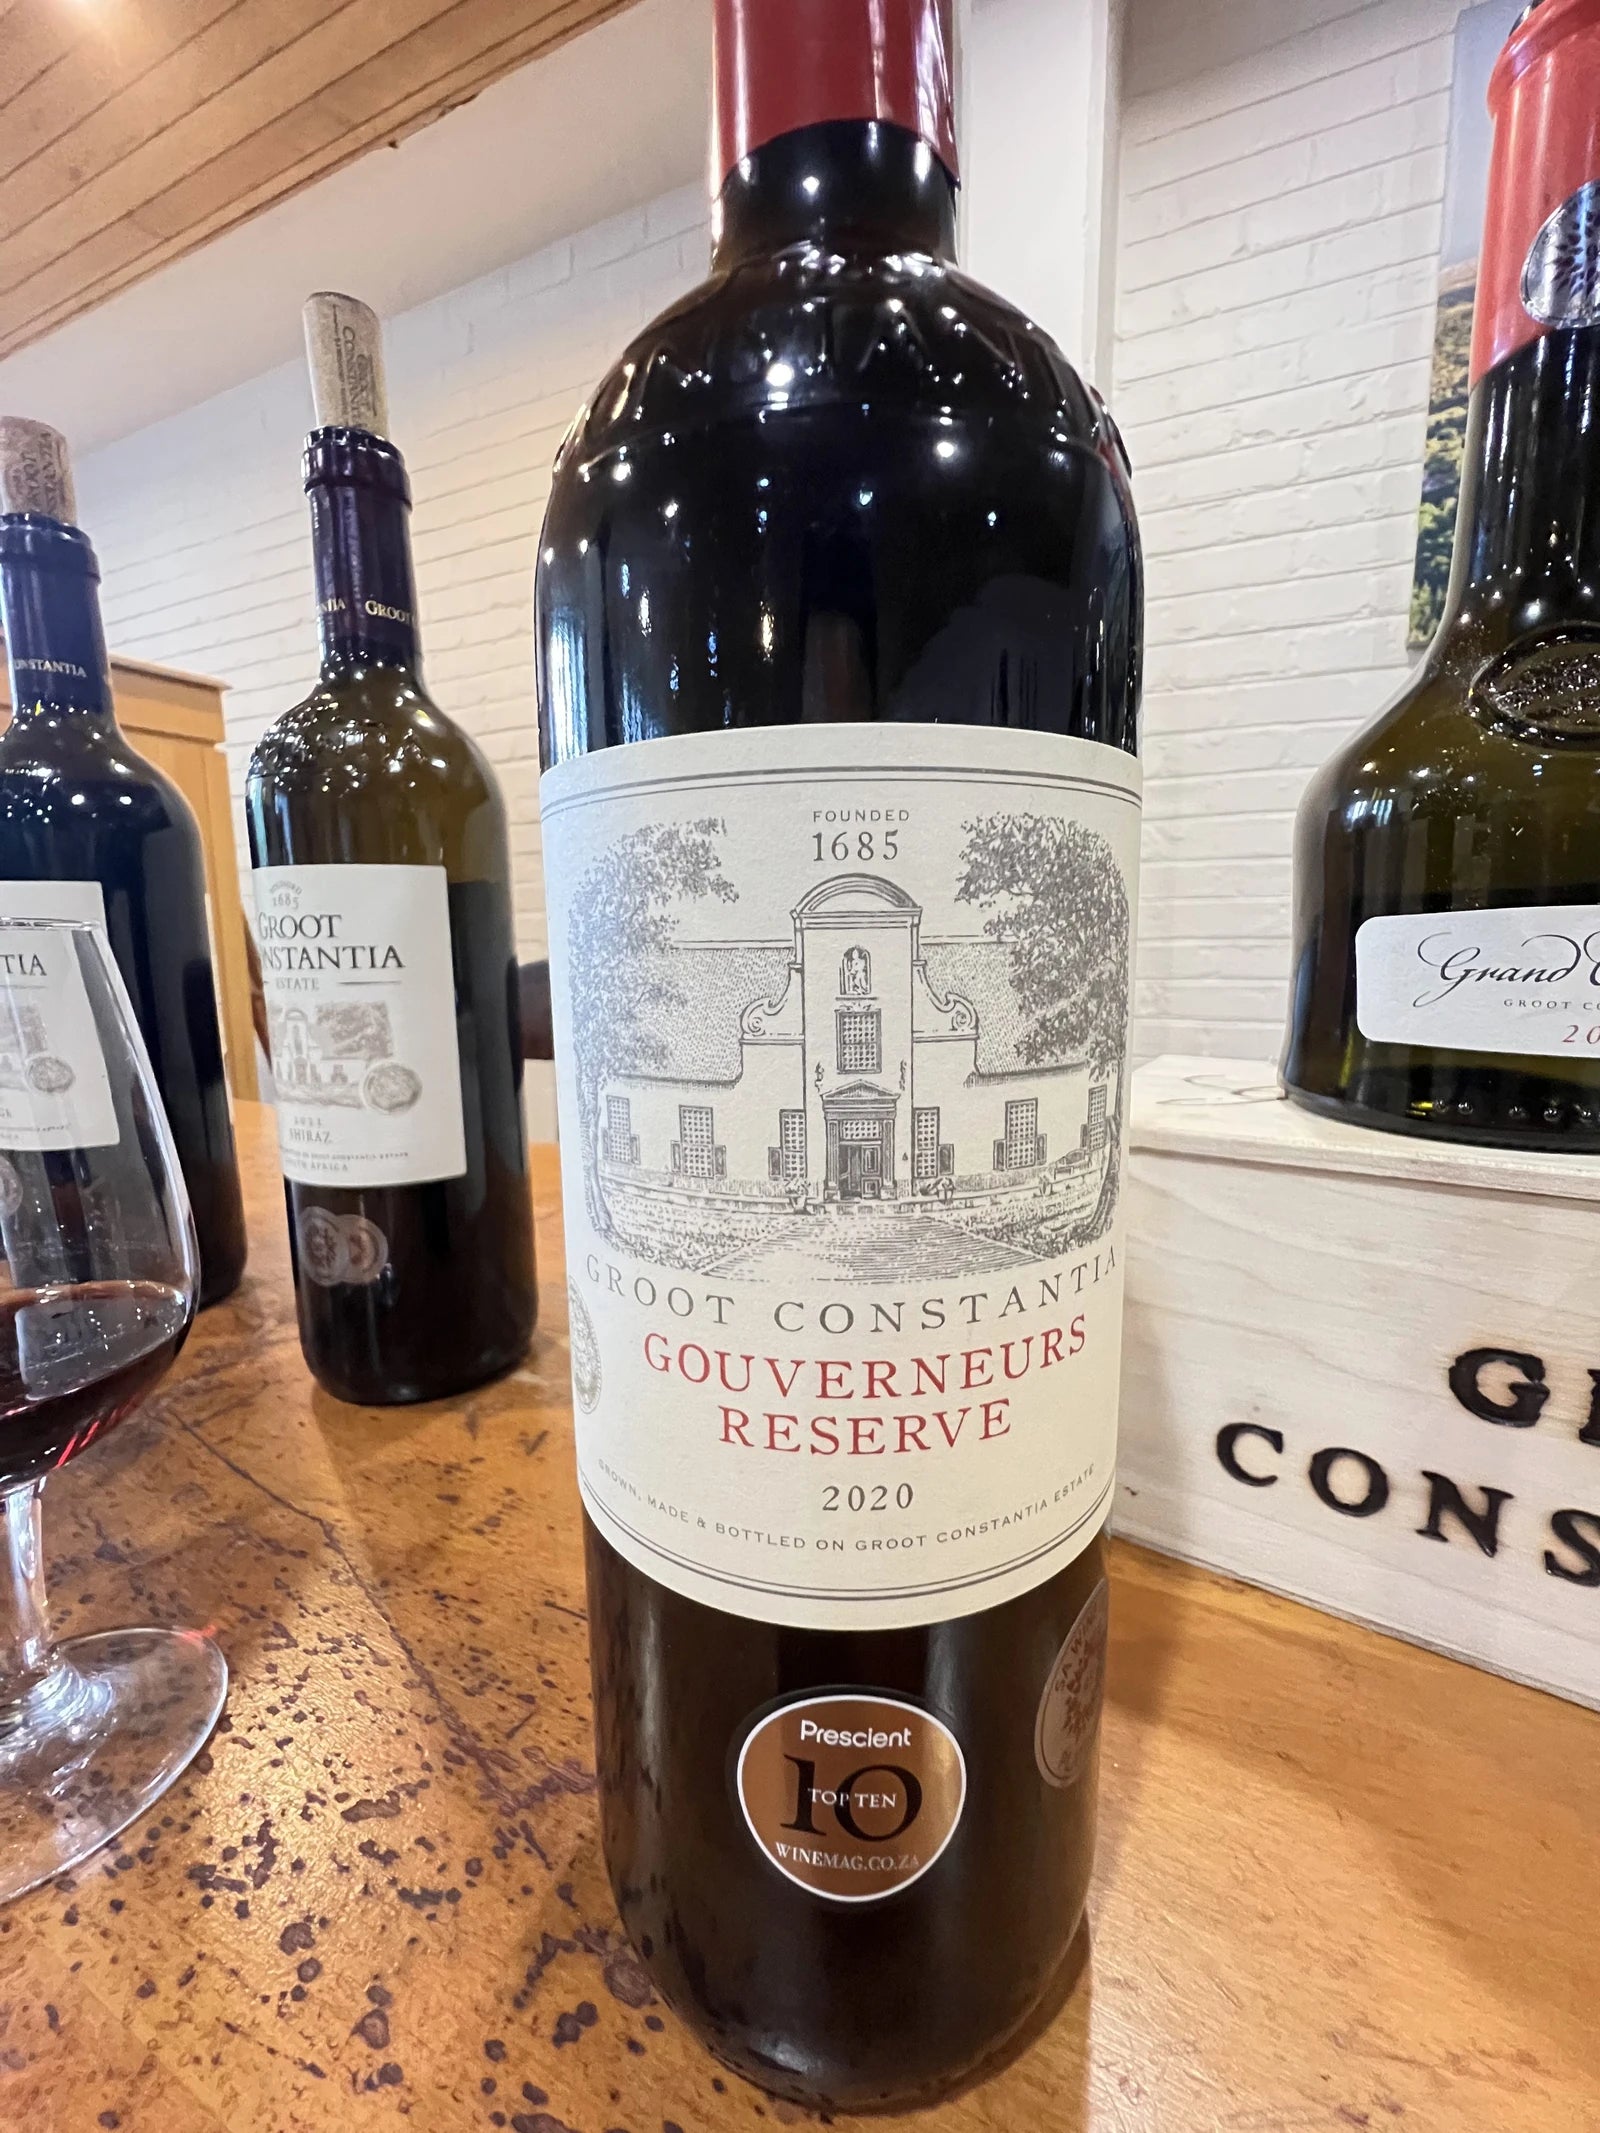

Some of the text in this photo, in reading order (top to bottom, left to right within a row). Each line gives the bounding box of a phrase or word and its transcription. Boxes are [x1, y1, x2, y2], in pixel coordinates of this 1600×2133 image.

[813, 809, 910, 822] FOUNDED
[812, 829, 899, 861] 1685
[258, 911, 342, 940] GROOT
[1412, 931, 1582, 1008] Grand
[1503, 998, 1600, 1011] GROOT C
[1562, 1024, 1600, 1045] 20
[289, 1128, 333, 1146] SHIRAZ
[586, 1245, 1116, 1334] GROOT CONSTANTIA
[644, 1314, 1086, 1399] GOUVERNEURS
[1448, 1347, 1600, 1448] G
[718, 1398, 1011, 1456] RESERVE
[598, 1459, 1095, 1551] GROWN, MADE & BOTTLED ON GROOT CONSTANTIA ESTATE
[822, 1483, 914, 1512] 2020
[800, 1719, 912, 1748] Prescient
[780, 1754, 923, 1842] 10
[807, 1788, 897, 1808] TOP TEN
[775, 1841, 920, 1872] WINEMAG.CO.ZA
